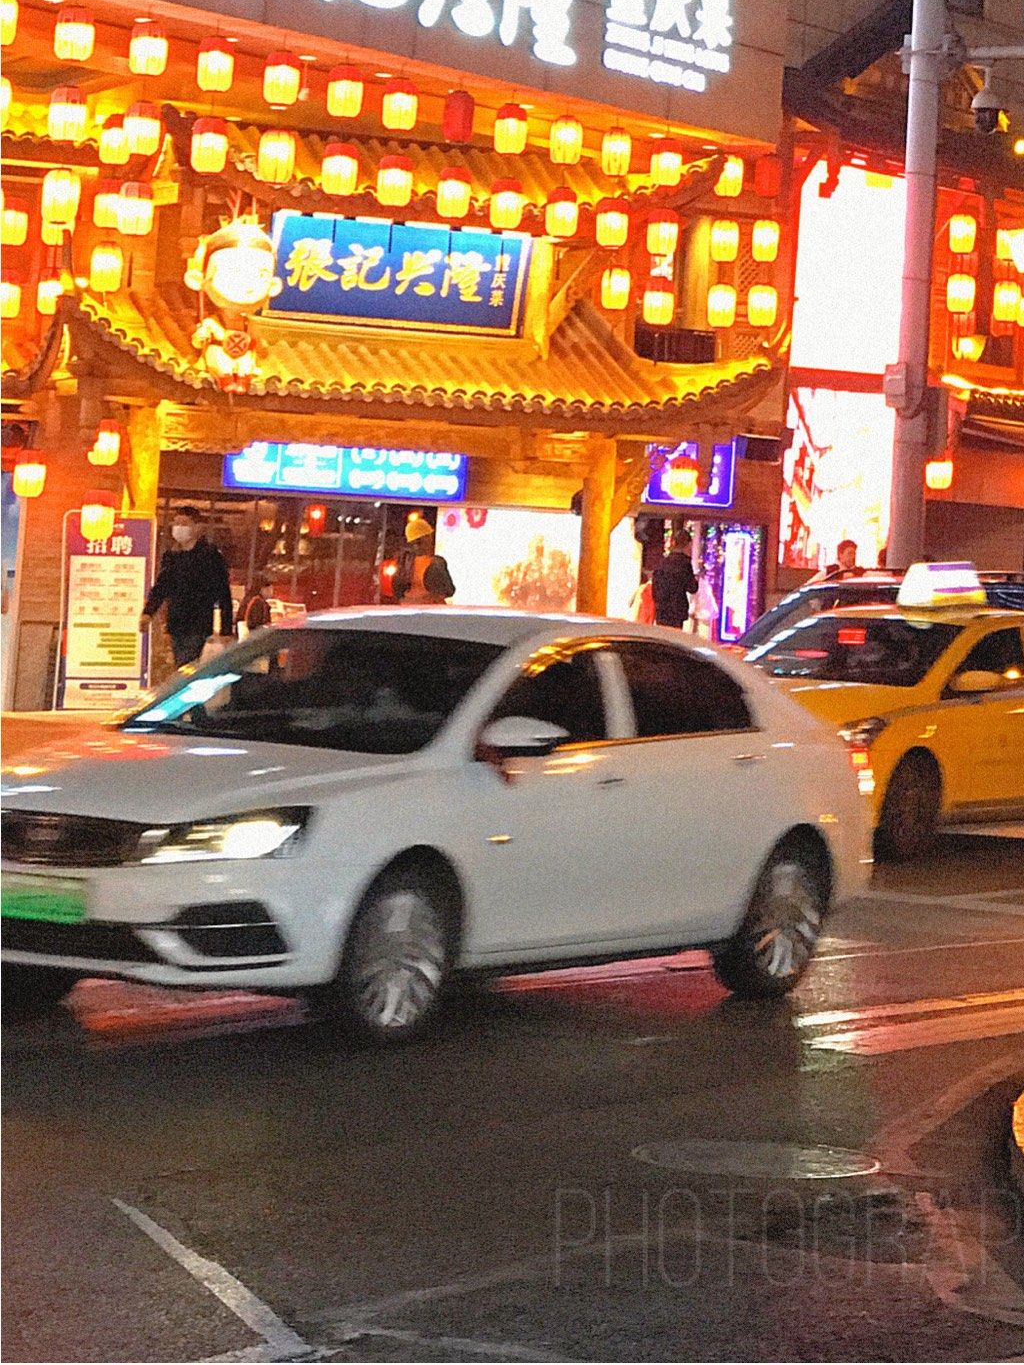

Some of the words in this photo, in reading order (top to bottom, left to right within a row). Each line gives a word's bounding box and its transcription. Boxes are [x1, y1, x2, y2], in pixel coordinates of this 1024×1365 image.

[488, 253, 511, 308] 重庆菜
[86, 536, 133, 555] 招聘
